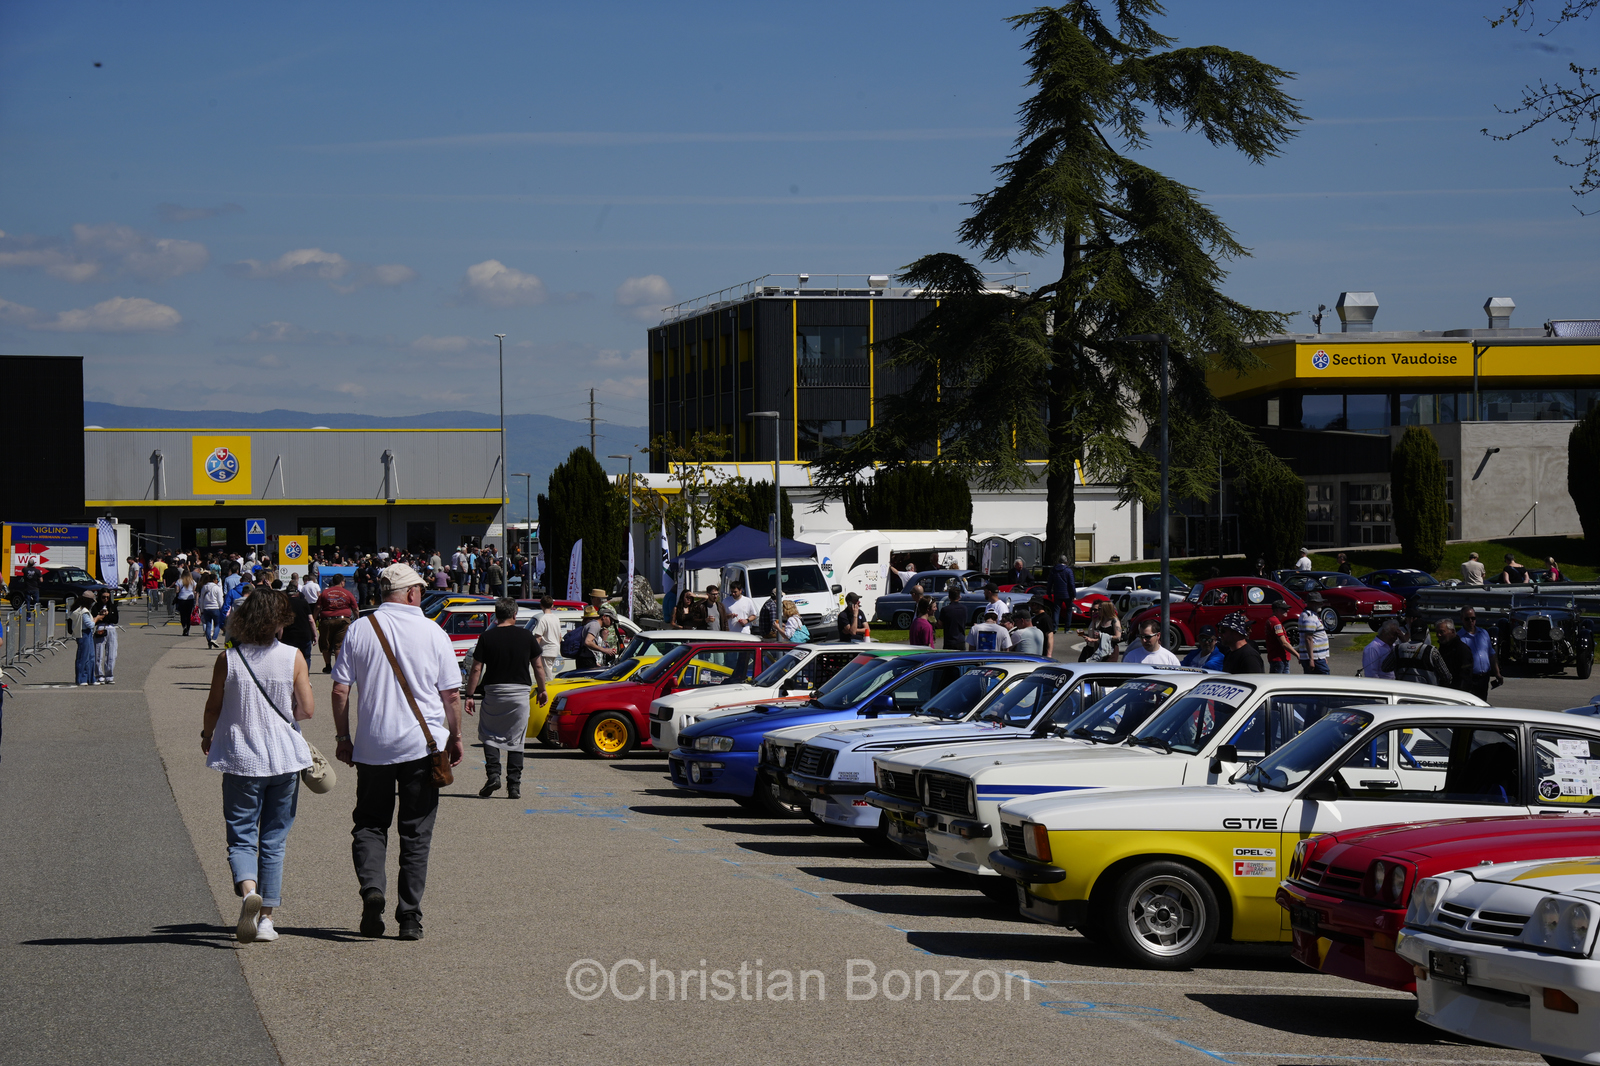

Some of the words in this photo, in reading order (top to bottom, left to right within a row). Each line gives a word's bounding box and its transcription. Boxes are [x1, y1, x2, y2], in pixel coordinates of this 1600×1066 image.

[1332, 353, 1386, 365] Section
[1391, 353, 1457, 365] Vaudoise
[33, 526, 68, 534] VIGLINO
[18, 555, 37, 564] WC
[1202, 684, 1244, 700] ESCORT
[1223, 818, 1278, 829] GT/E
